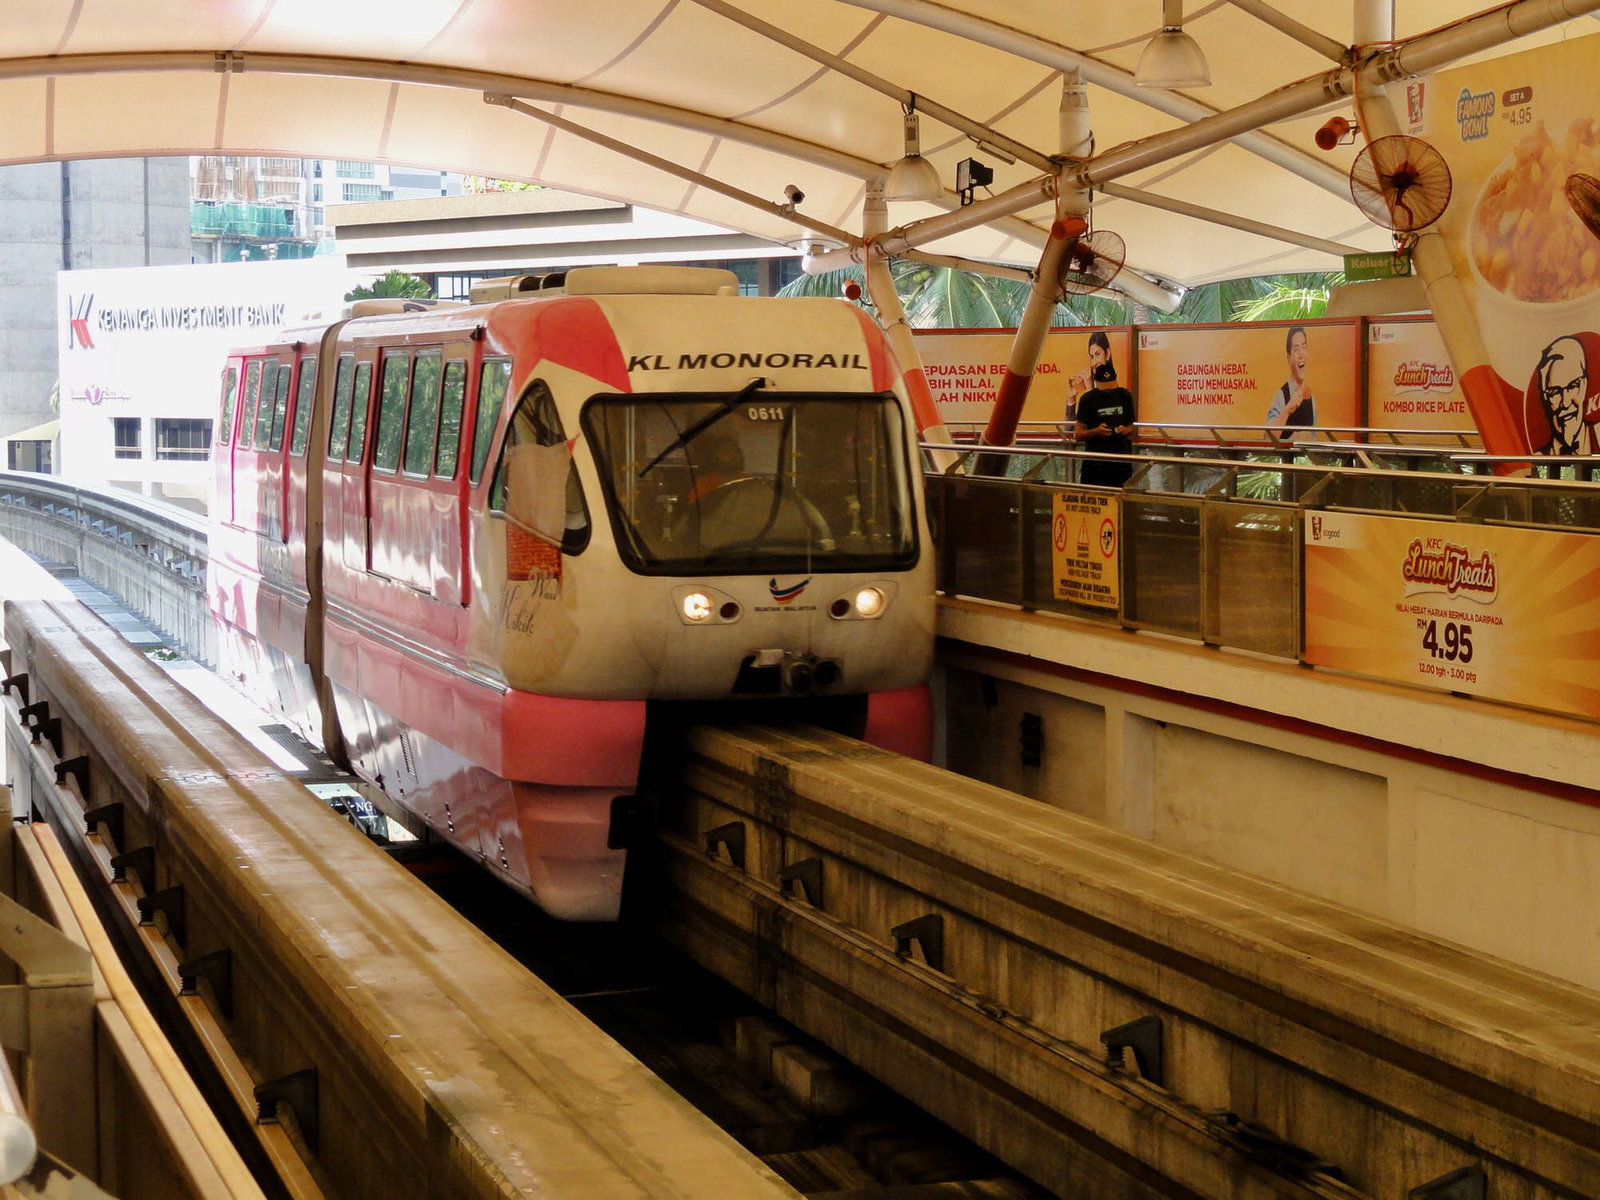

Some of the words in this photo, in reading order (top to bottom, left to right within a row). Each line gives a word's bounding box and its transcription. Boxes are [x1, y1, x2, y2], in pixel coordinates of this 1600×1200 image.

[1458, 94, 1494, 121] FAMOUS
[1510, 107, 1532, 126] 4.95
[1463, 117, 1488, 138] BOWL
[1351, 258, 1389, 269] Keluar
[99, 307, 158, 332] KENANGA
[161, 304, 243, 329] INVESTMENT
[247, 303, 286, 328] BANK
[627, 354, 671, 372] KL
[677, 352, 868, 370] MONORAIL
[923, 364, 987, 376] EPUASAN
[1177, 363, 1220, 375] GABUNGAN
[1222, 363, 1249, 375] HEBAT.
[955, 378, 995, 389] NILAI.
[1177, 379, 1204, 390] BEGITU
[1206, 378, 1258, 390] MEMUASKAN.
[1395, 364, 1427, 385] Lunch
[1424, 365, 1453, 388] Treats
[1177, 394, 1203, 405] INILAH
[1204, 393, 1235, 405] NIKMAT.
[1383, 401, 1415, 413] KOMBO
[1416, 401, 1436, 413] RICE
[1437, 401, 1465, 413] PLATE
[749, 407, 784, 421] 0611
[1426, 538, 1442, 549] KFC
[1404, 545, 1452, 581] Lunch
[1450, 549, 1494, 588] Treats
[1395, 603, 1410, 613] NILAI
[1410, 605, 1426, 615] HEBAT
[1427, 608, 1447, 618] HARIAN
[1448, 610, 1474, 622] BERMULA
[1475, 614, 1504, 626] DARIPADA
[1417, 618, 1427, 629] RM
[1423, 620, 1473, 663] 4.95
[1418, 662, 1435, 674] 12.00
[1435, 666, 1447, 678] tgh
[1451, 668, 1465, 680] 3.00
[1465, 670, 1477, 684] ptg
